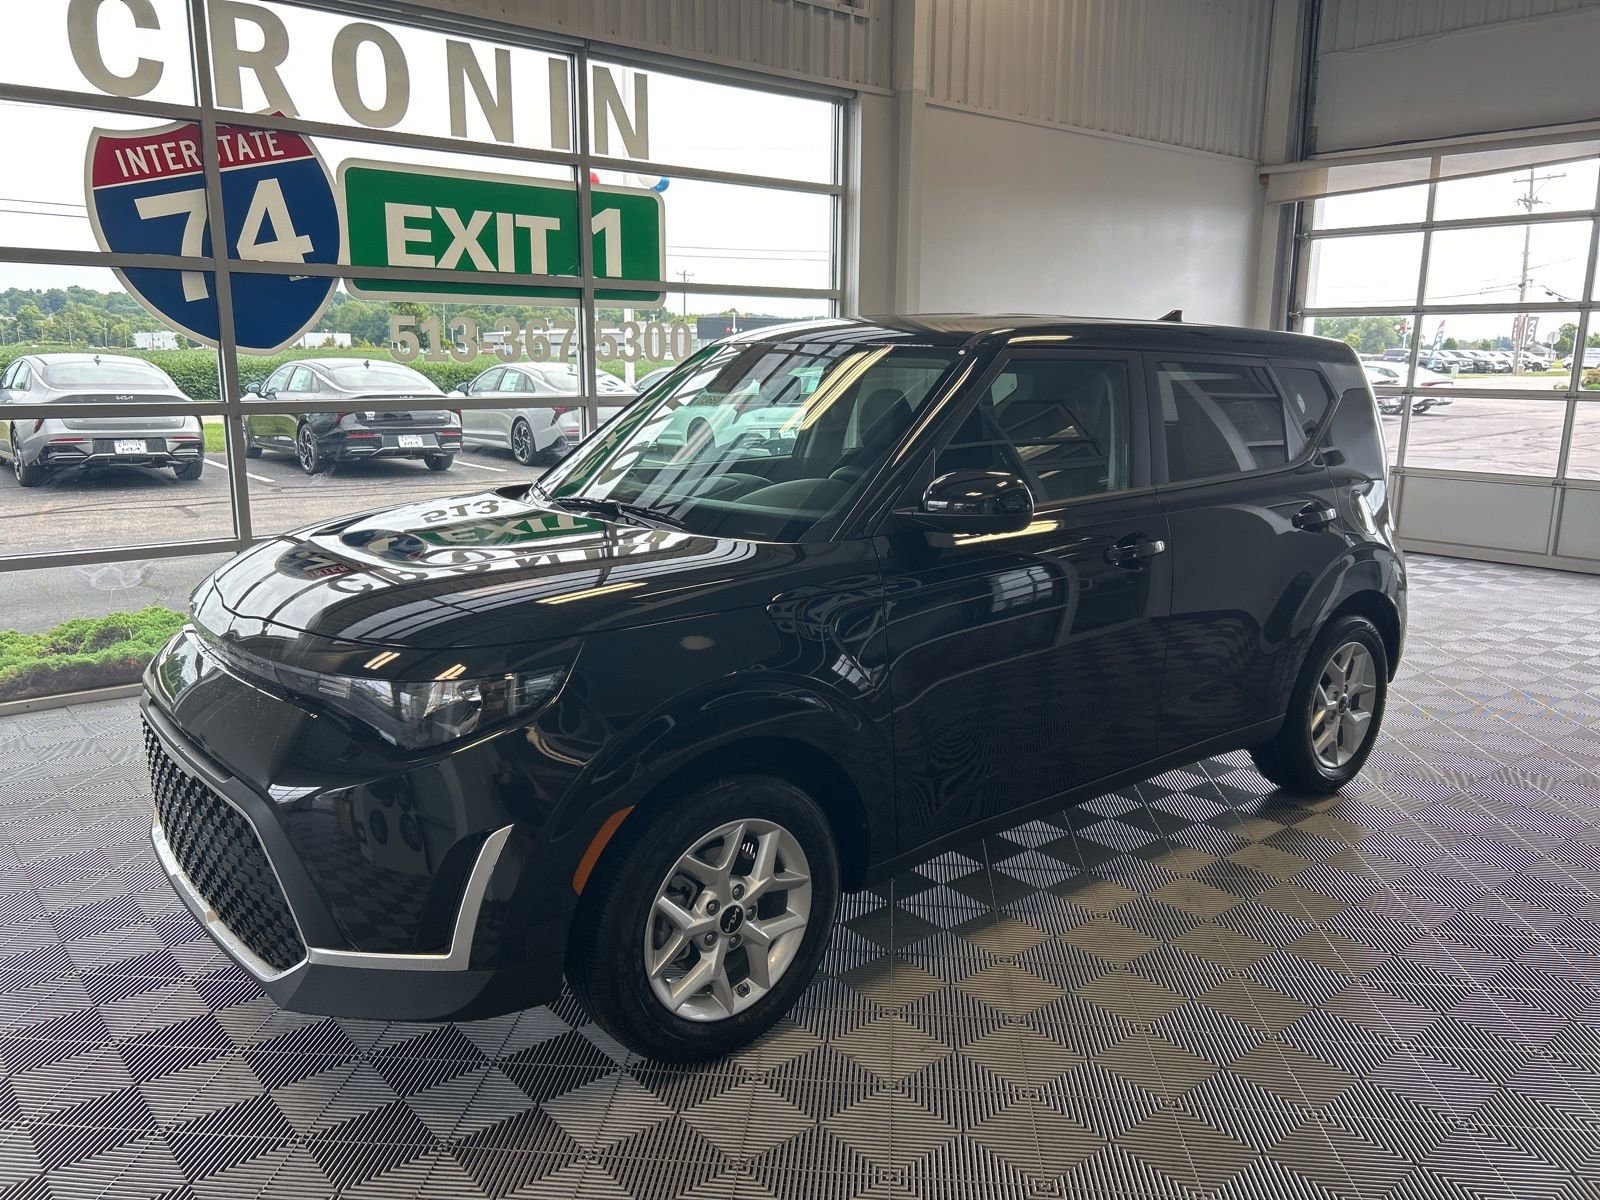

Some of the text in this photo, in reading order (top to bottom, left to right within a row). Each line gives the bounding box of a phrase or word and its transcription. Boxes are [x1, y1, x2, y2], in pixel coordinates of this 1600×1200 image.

[66, 0, 649, 160] CRONIN
[115, 130, 285, 177] INTERTATE
[134, 178, 314, 302] 74
[384, 202, 622, 278] EXIT 1
[389, 315, 692, 363] 513-3675300
